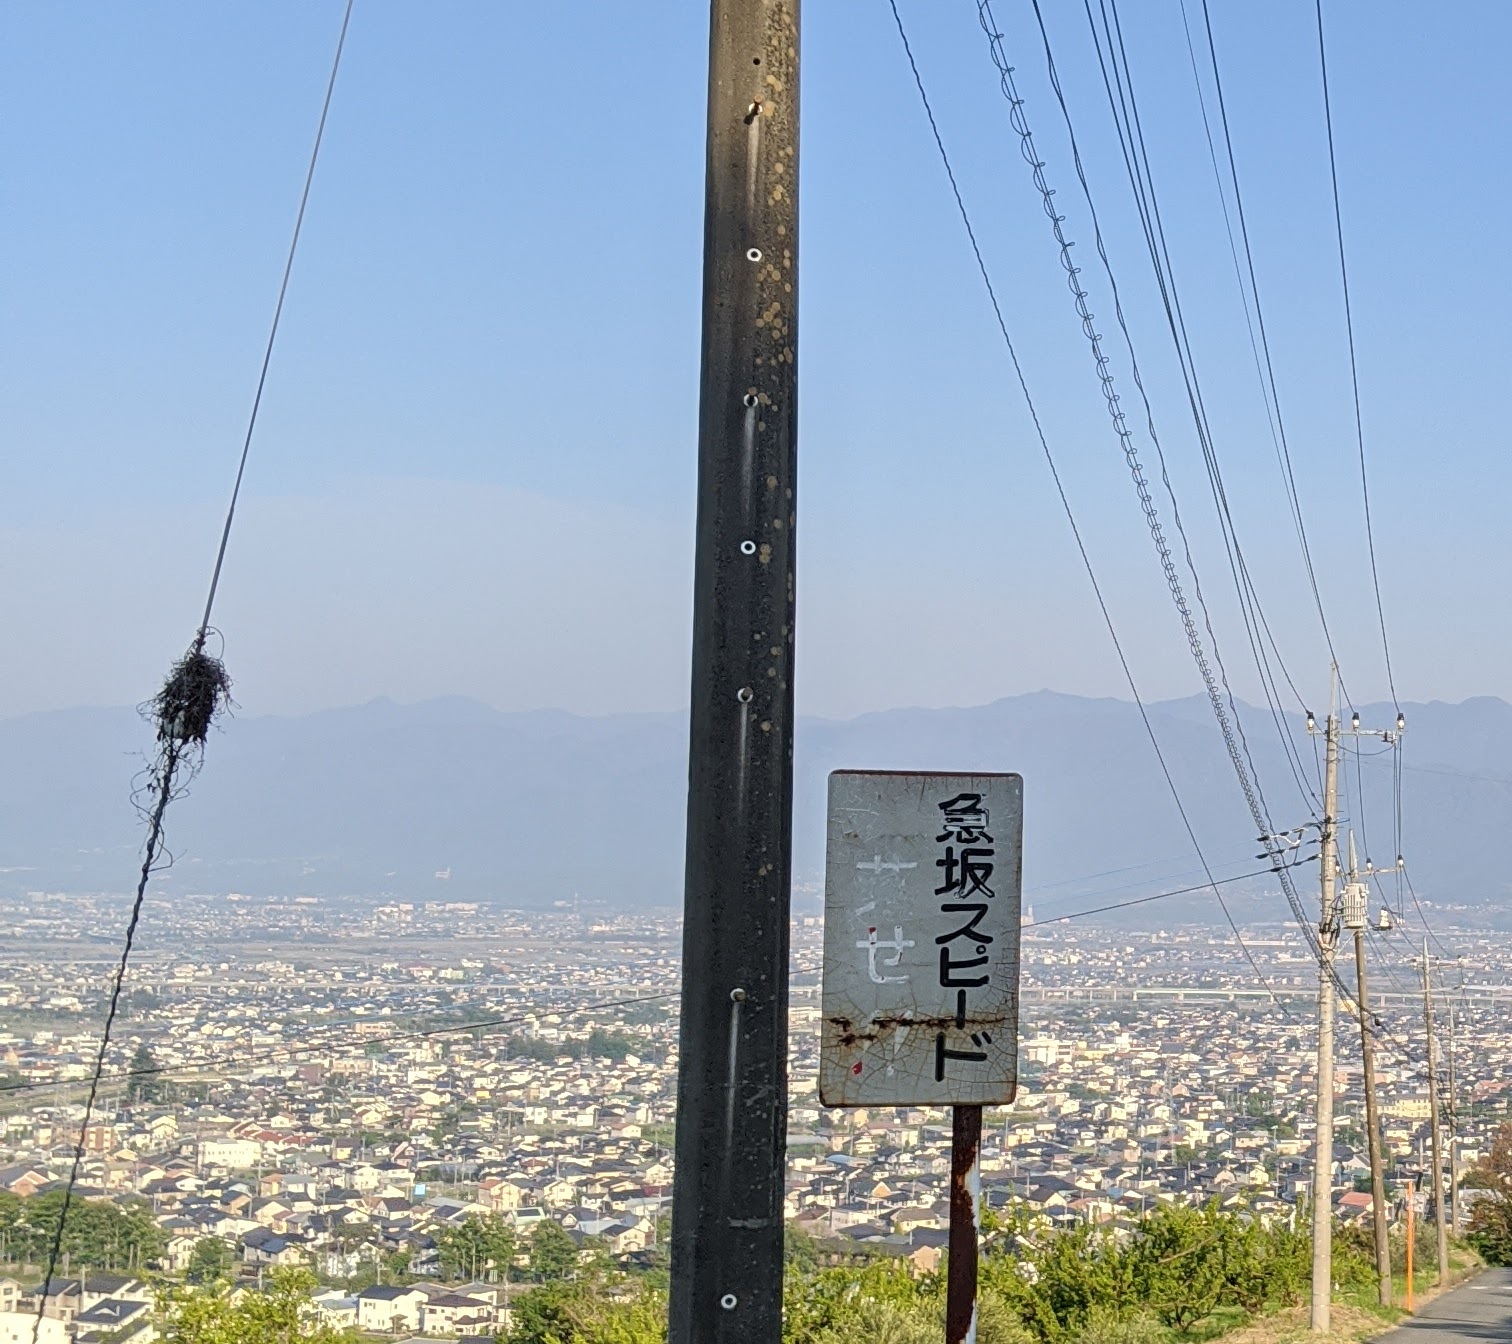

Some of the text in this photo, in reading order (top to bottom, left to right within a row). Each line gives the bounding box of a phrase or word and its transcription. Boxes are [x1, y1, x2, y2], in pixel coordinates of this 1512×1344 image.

[935, 792, 995, 1083] 急坂スピード
